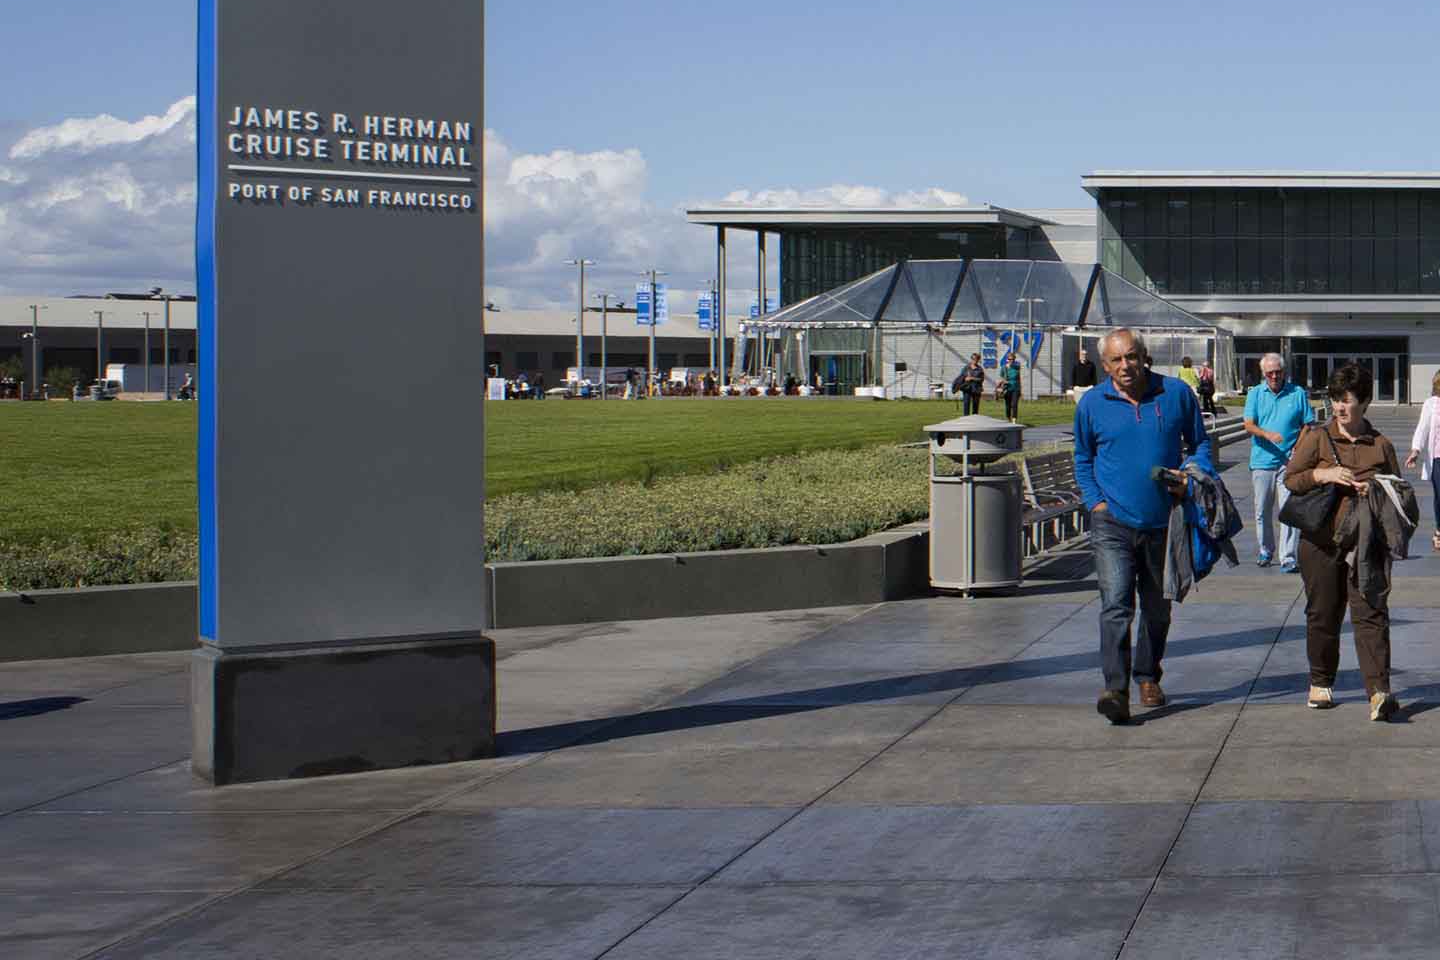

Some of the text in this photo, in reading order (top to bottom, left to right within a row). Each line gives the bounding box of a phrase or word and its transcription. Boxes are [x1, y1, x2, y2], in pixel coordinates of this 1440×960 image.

[228, 106, 471, 141] JAMES R. HERMAN
[228, 133, 472, 167] CRUISE TERMINAL
[229, 182, 472, 209] PORT OF SAN FRANCISCO
